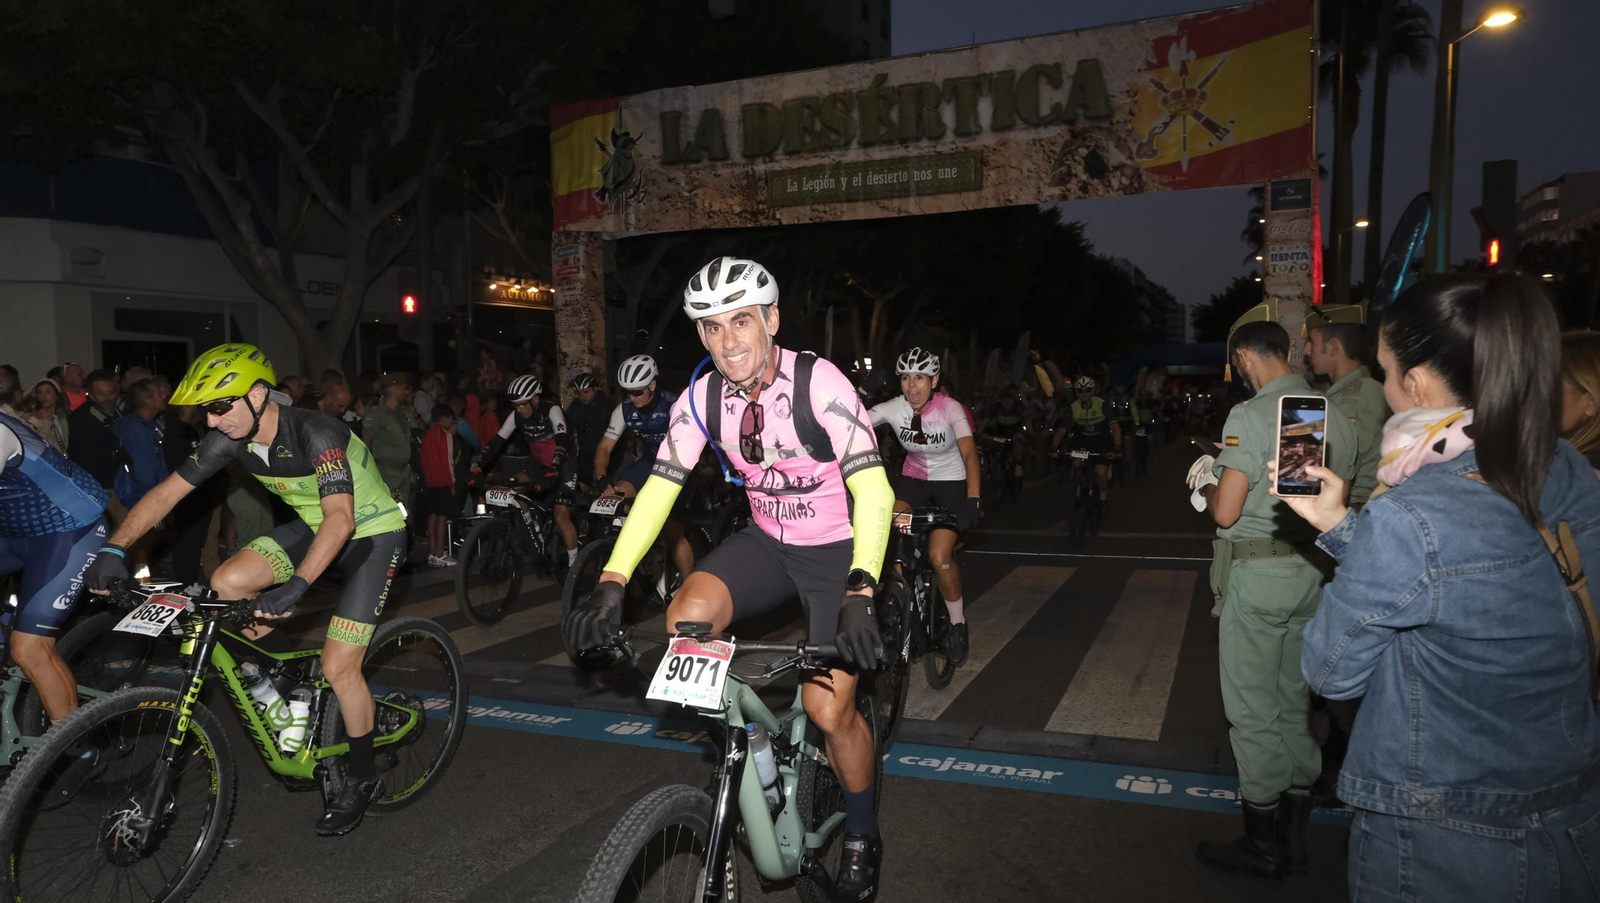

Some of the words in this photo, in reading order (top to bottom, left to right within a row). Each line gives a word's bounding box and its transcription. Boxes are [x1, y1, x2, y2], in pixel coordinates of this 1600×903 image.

[660, 107, 730, 164] LA
[741, 58, 1114, 157] DESÉRTICA
[787, 178, 798, 192] La
[802, 174, 836, 193] Legión
[840, 175, 848, 190] y
[852, 172, 862, 187] el
[866, 170, 908, 186] desierto
[914, 171, 932, 181] nos
[938, 167, 958, 179] une
[1270, 252, 1309, 262] RENTA
[900, 426, 946, 445] TRAMAN
[315, 459, 346, 477] BIKE
[489, 490, 508, 501] 9076
[596, 499, 617, 508] 6824
[374, 547, 402, 617] CabraBIKE
[131, 604, 175, 625] 8682
[665, 656, 721, 687] 9071
[898, 755, 1065, 781] cajamar
[972, 771, 1009, 782] CAJA
[1010, 774, 1055, 785] RURAL
